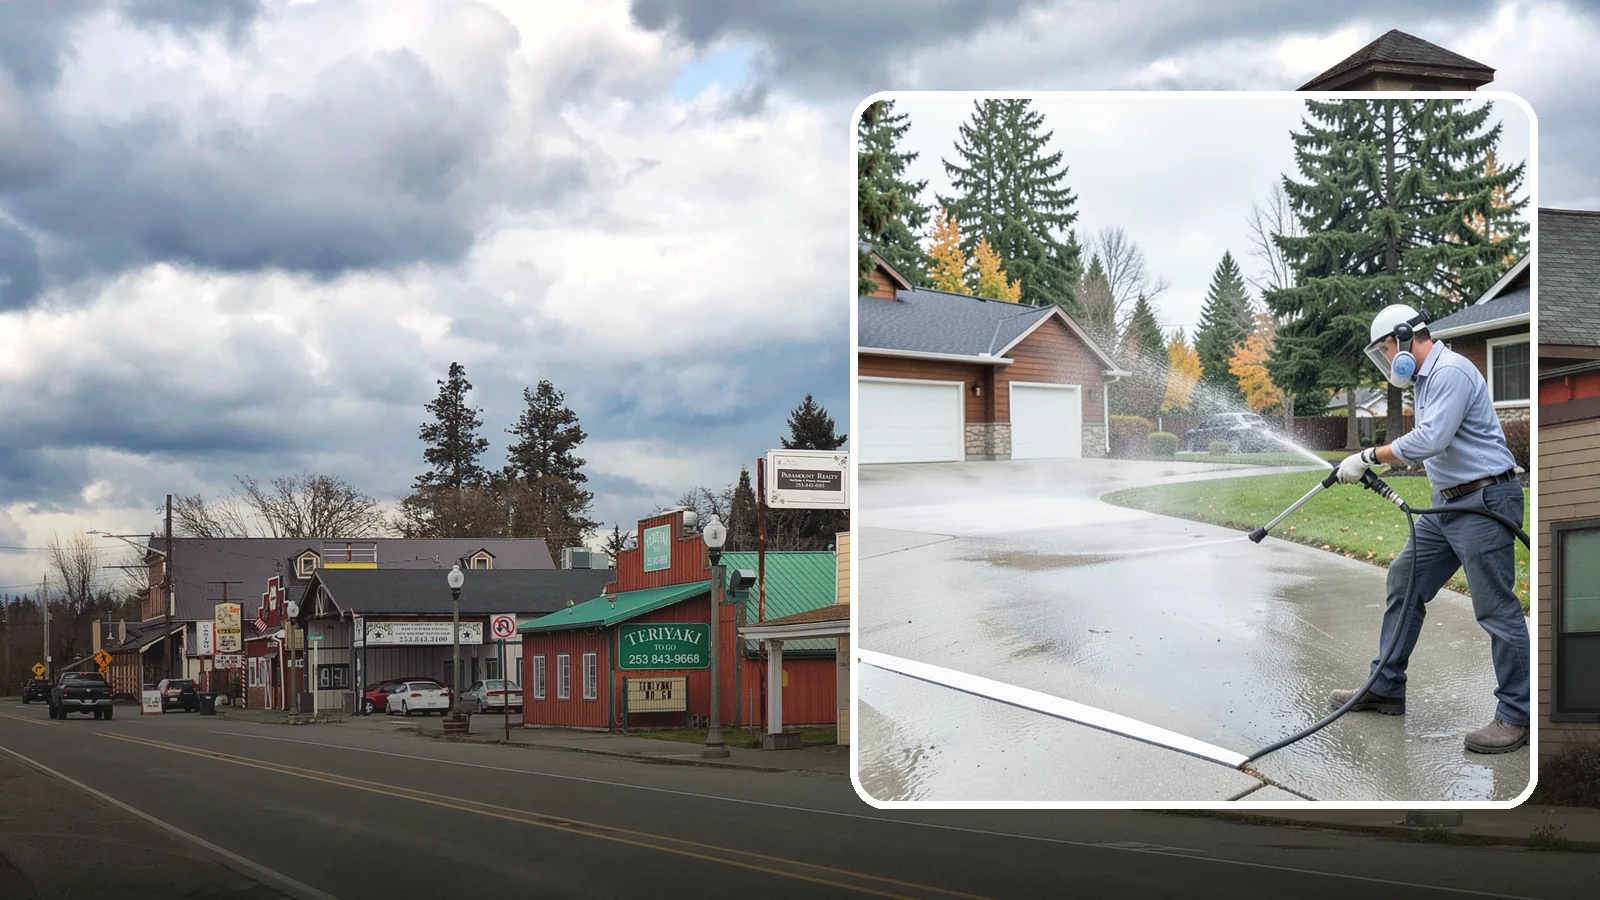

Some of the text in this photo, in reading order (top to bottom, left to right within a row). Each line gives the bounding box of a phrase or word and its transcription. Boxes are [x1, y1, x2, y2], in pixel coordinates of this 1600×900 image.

[781, 471, 839, 480] PARAMOUNT REALTY
[646, 531, 669, 549] TERIYAKI
[624, 627, 703, 646] TERIYAKI
[653, 643, 677, 651] TO GO
[628, 653, 700, 665] 253 843-9668
